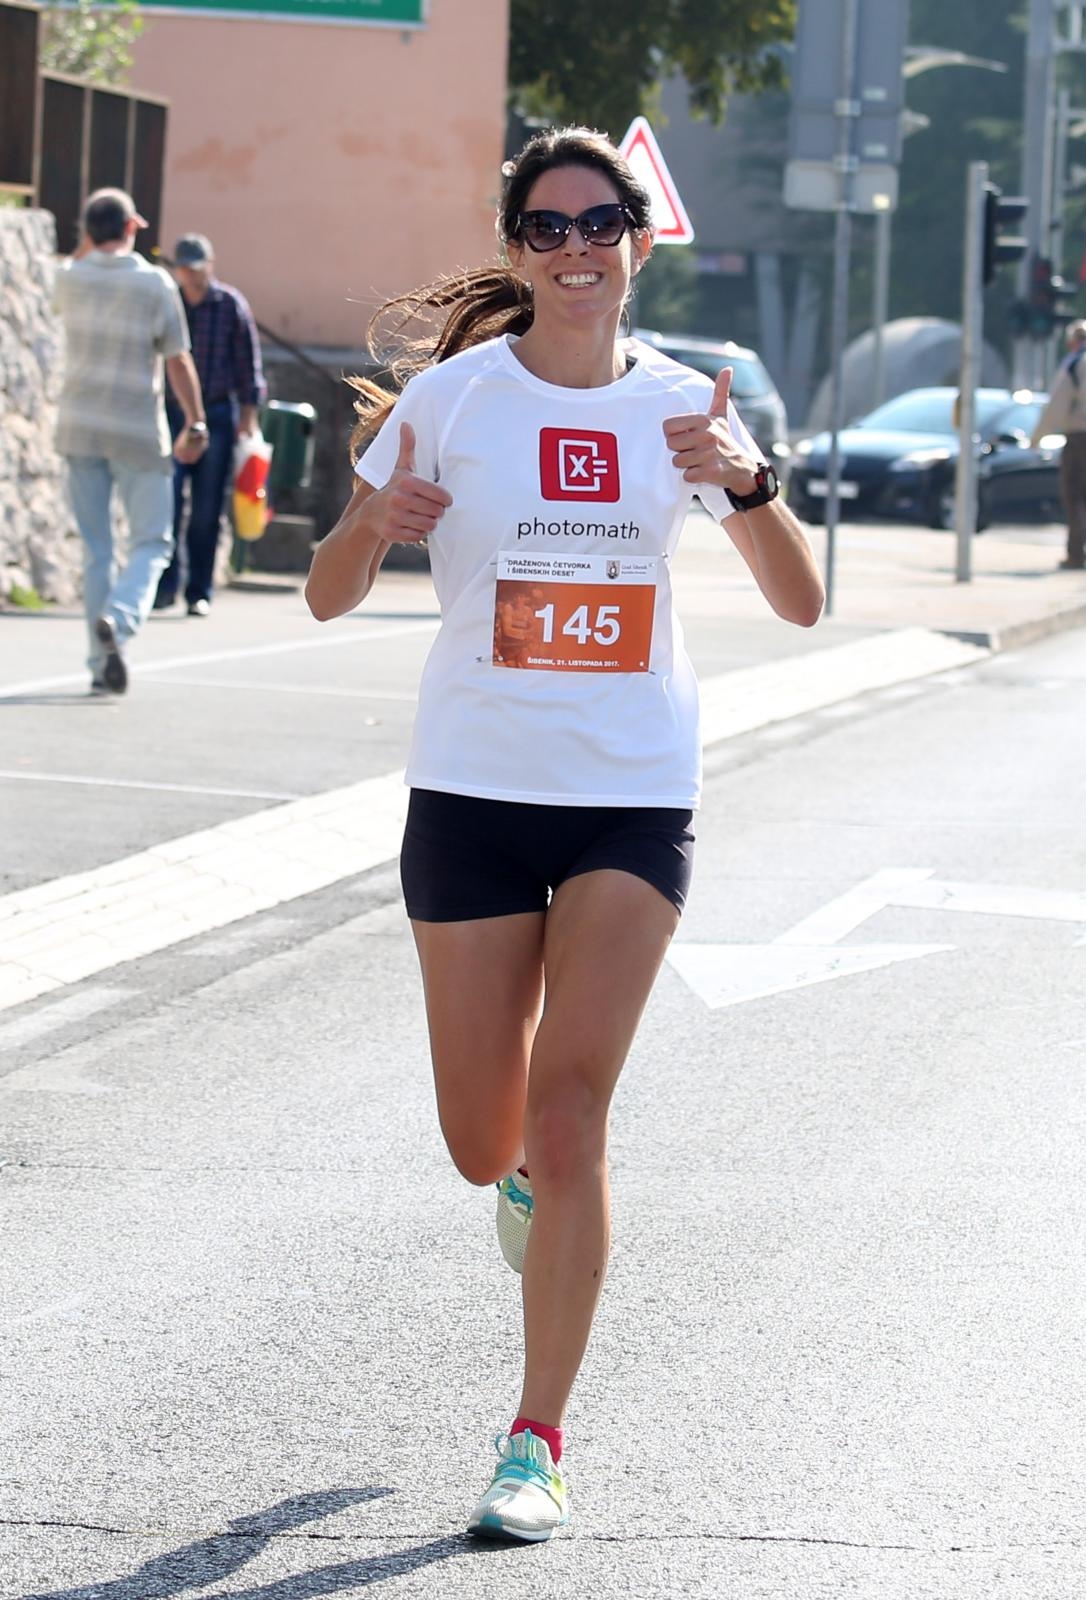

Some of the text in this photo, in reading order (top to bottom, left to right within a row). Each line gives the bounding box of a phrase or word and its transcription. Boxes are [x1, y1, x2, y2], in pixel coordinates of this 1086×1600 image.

[517, 516, 640, 540] photomath
[507, 559, 591, 570] DRAŽENOVA ČETVORKA
[511, 567, 550, 576] ŠIBENSKIH
[551, 569, 576, 577] DESET
[534, 603, 621, 646] 145
